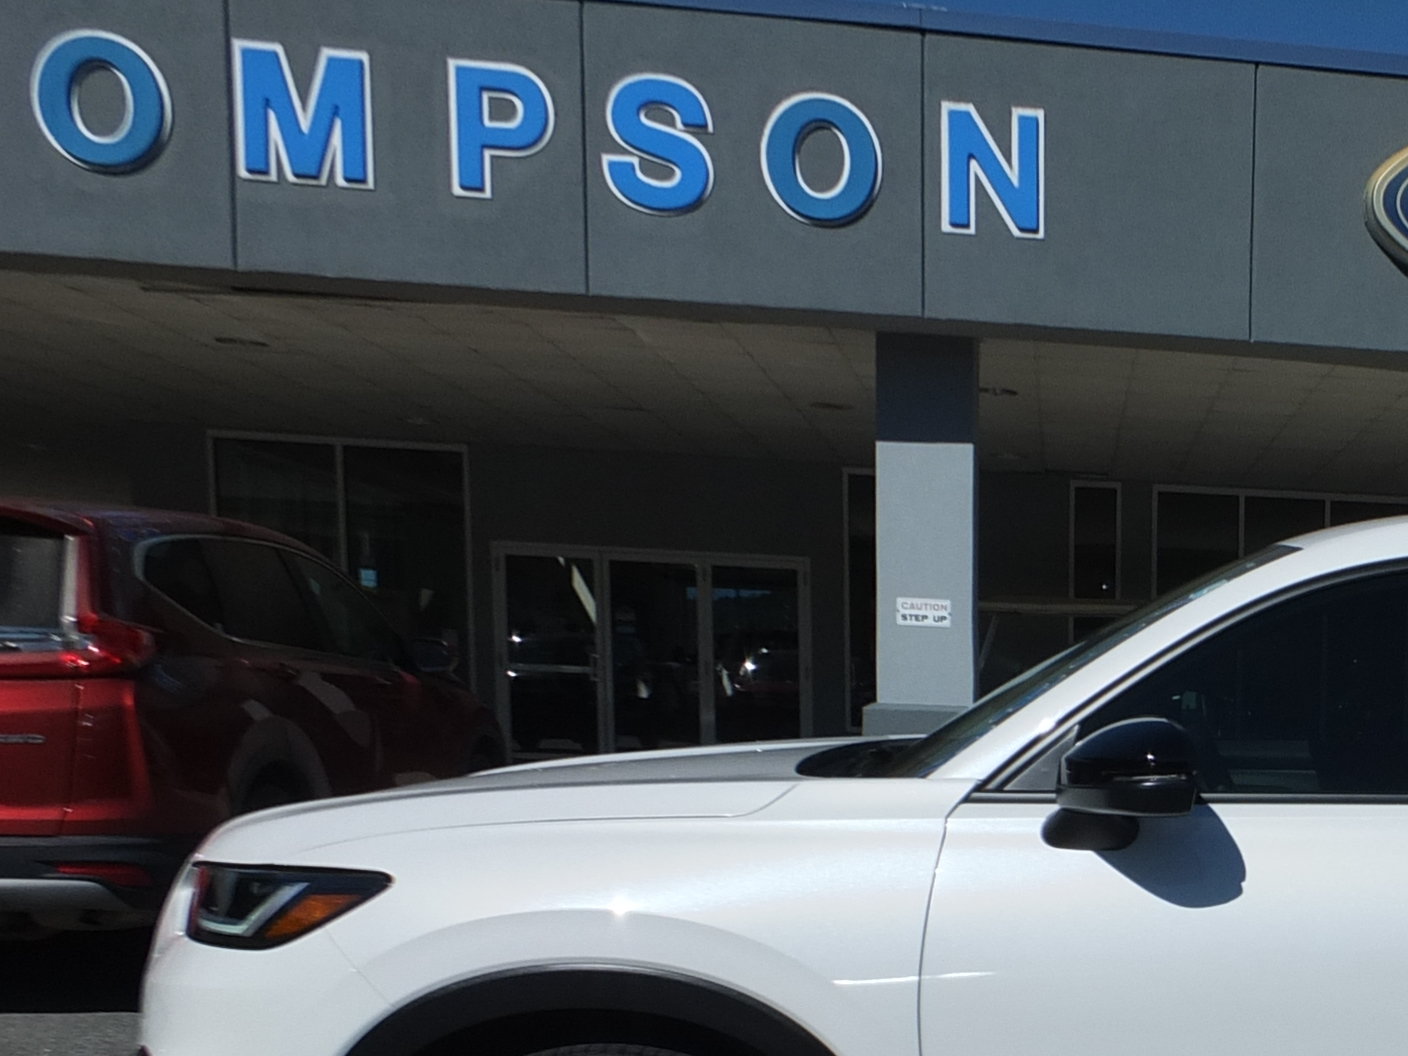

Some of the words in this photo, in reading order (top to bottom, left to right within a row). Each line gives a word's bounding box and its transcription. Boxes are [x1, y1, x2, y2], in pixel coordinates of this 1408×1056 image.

[30, 29, 1045, 239] OMPSON
[901, 602, 948, 611] CAUTION
[902, 614, 929, 622] STEP
[933, 615, 947, 623] UP
